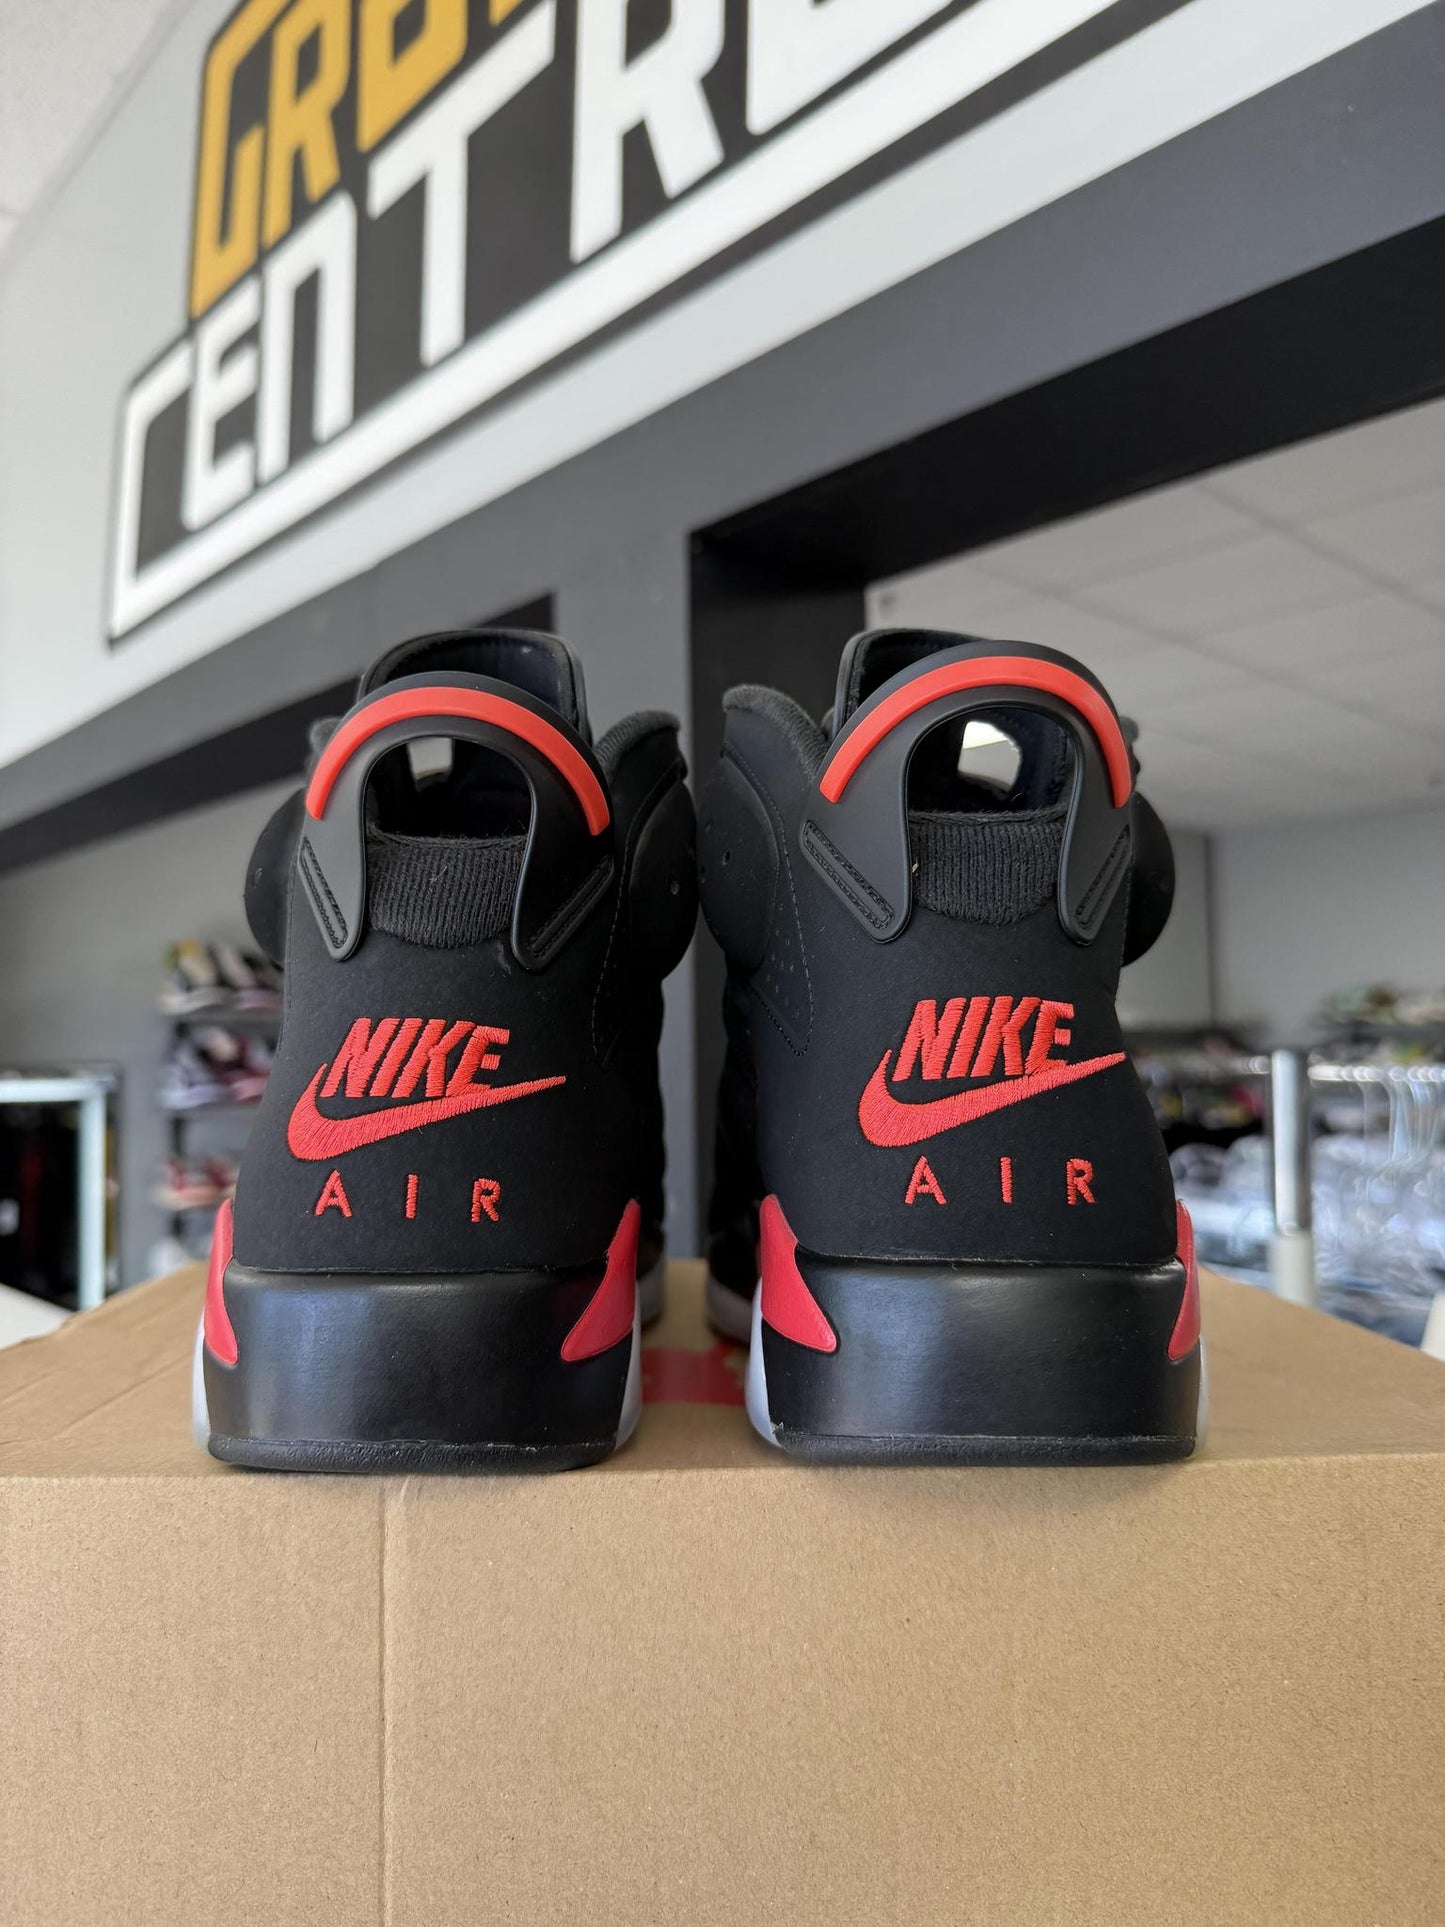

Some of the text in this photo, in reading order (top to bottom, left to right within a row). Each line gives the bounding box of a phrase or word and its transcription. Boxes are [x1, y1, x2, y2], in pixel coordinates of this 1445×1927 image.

[319, 1017, 510, 1098] NIKE
[892, 996, 1074, 1081] NIKE
[315, 1169, 501, 1223] AIR
[904, 1156, 1095, 1205] AIR
